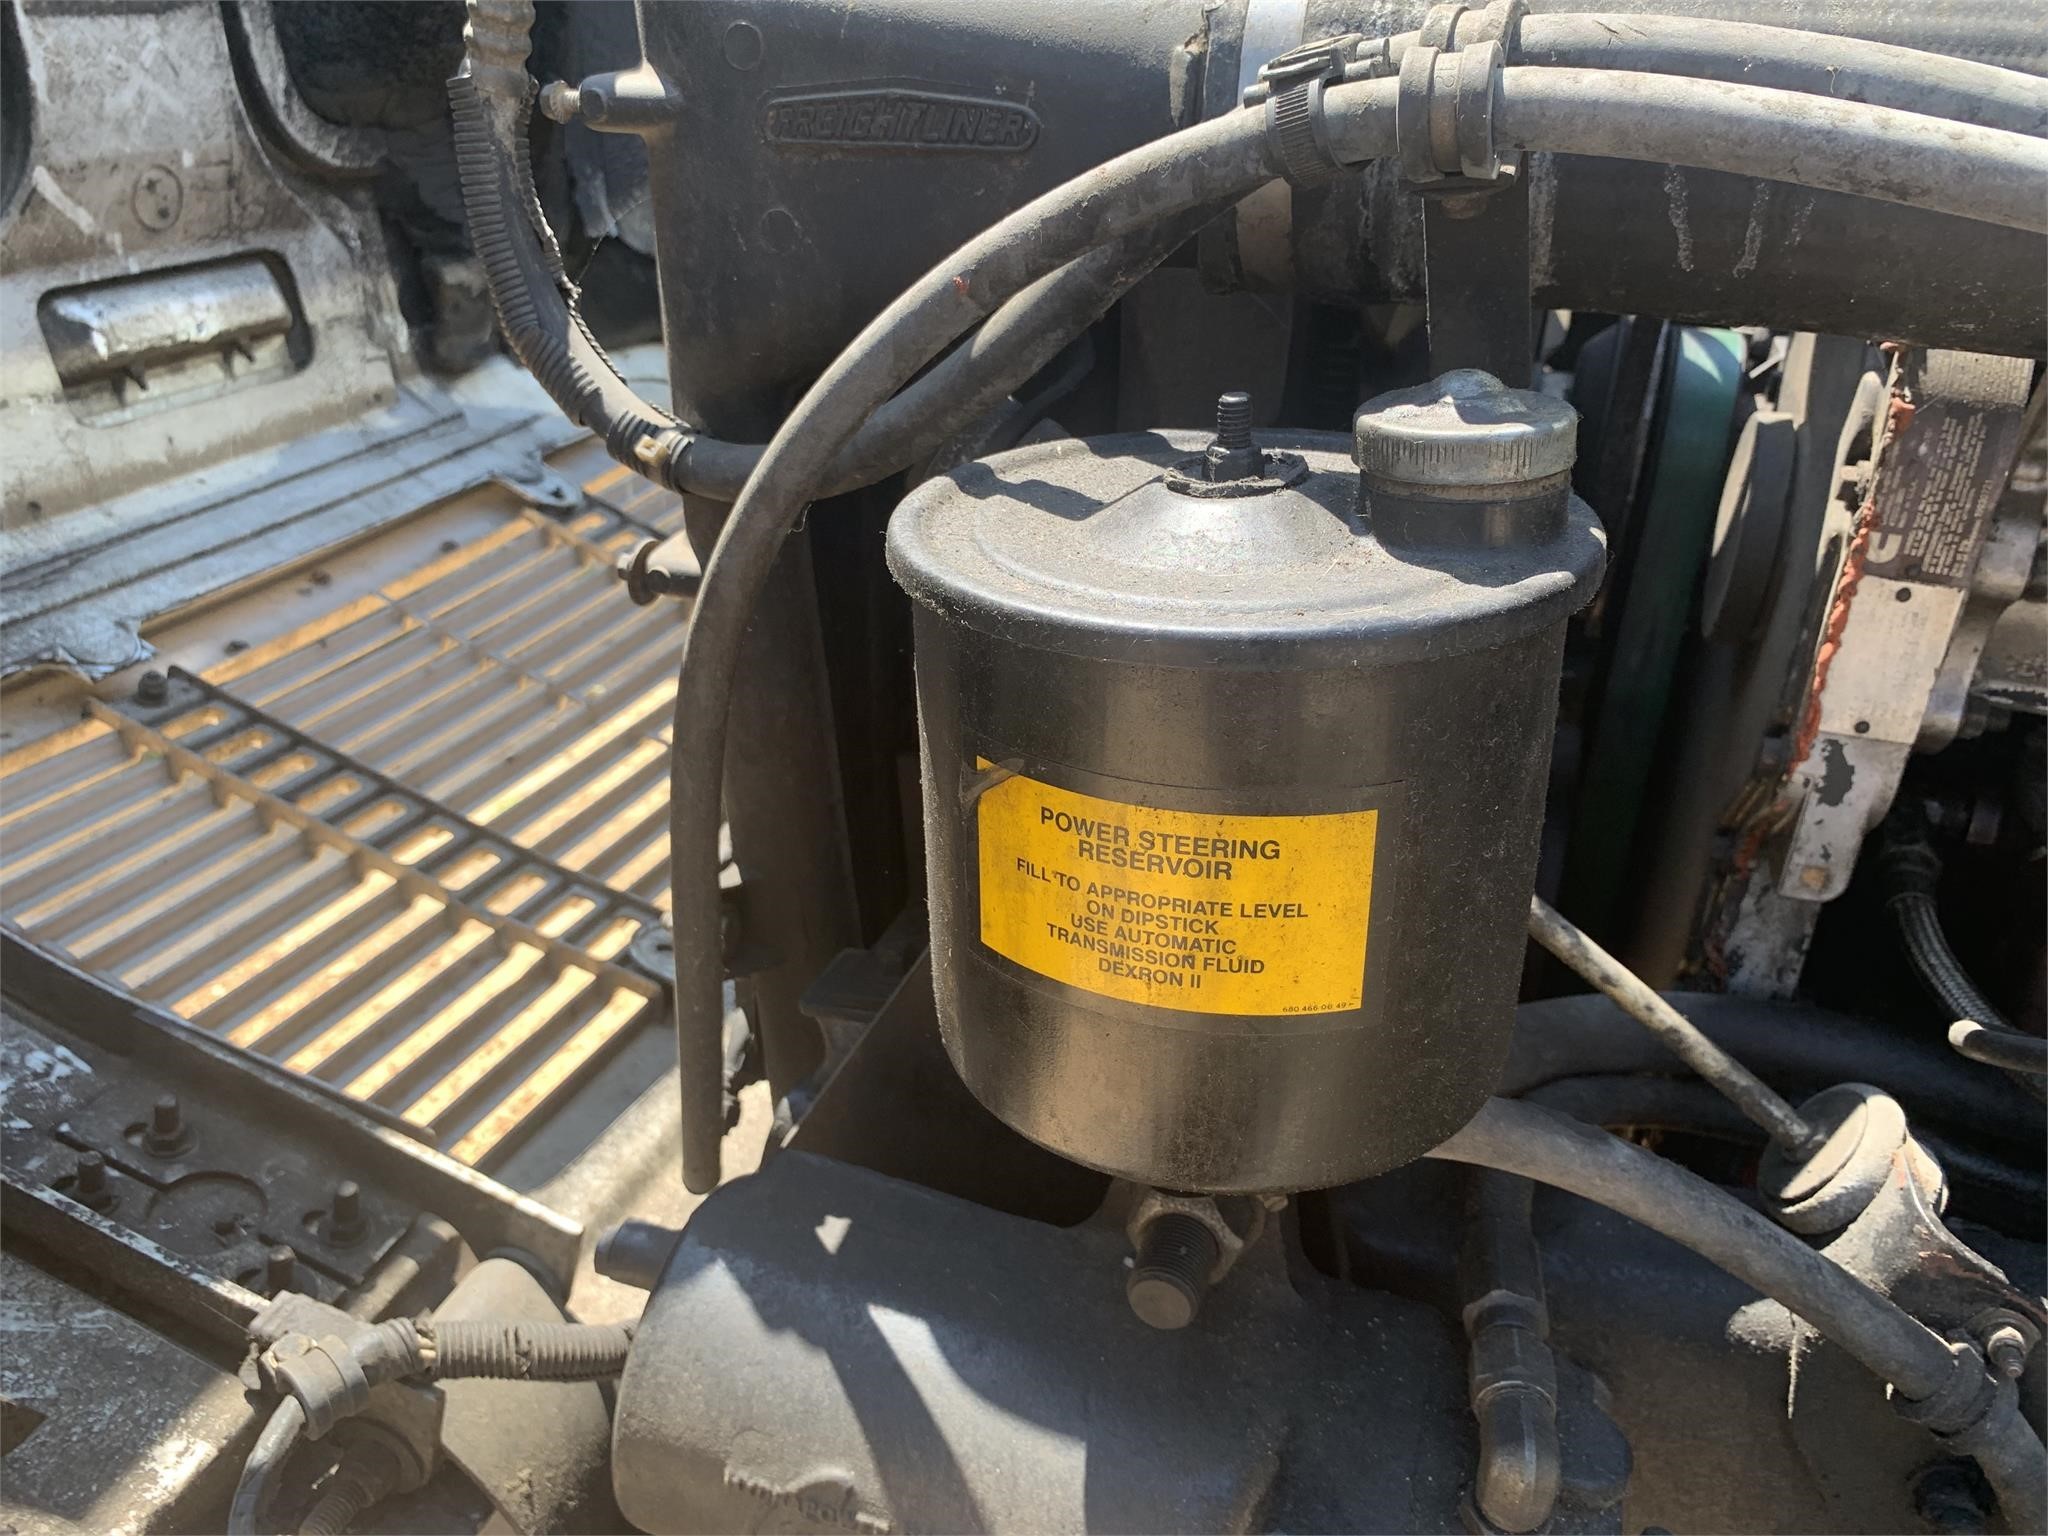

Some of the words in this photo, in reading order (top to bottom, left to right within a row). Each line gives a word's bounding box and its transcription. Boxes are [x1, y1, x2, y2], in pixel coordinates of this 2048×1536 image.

[774, 102, 1026, 145] FREIGHTLINER
[1041, 806, 1130, 847] POWER
[1138, 830, 1281, 860] STEERING
[1078, 839, 1233, 881] RESERVOIR
[1017, 857, 1051, 883] FILL
[1054, 871, 1081, 891] TO
[1086, 882, 1233, 917] APPROPRIATE
[1240, 903, 1309, 918] LEVEL
[1071, 913, 1109, 937] USE
[1114, 926, 1237, 955] AUTOMATIC
[1087, 900, 1115, 920] ON
[1121, 909, 1220, 936] DIPSTICK
[1047, 923, 1196, 970] TRANSMISSION
[1203, 957, 1265, 974] FLUID
[1099, 957, 1183, 989] DEXRON
[1190, 974, 1201, 989] II
